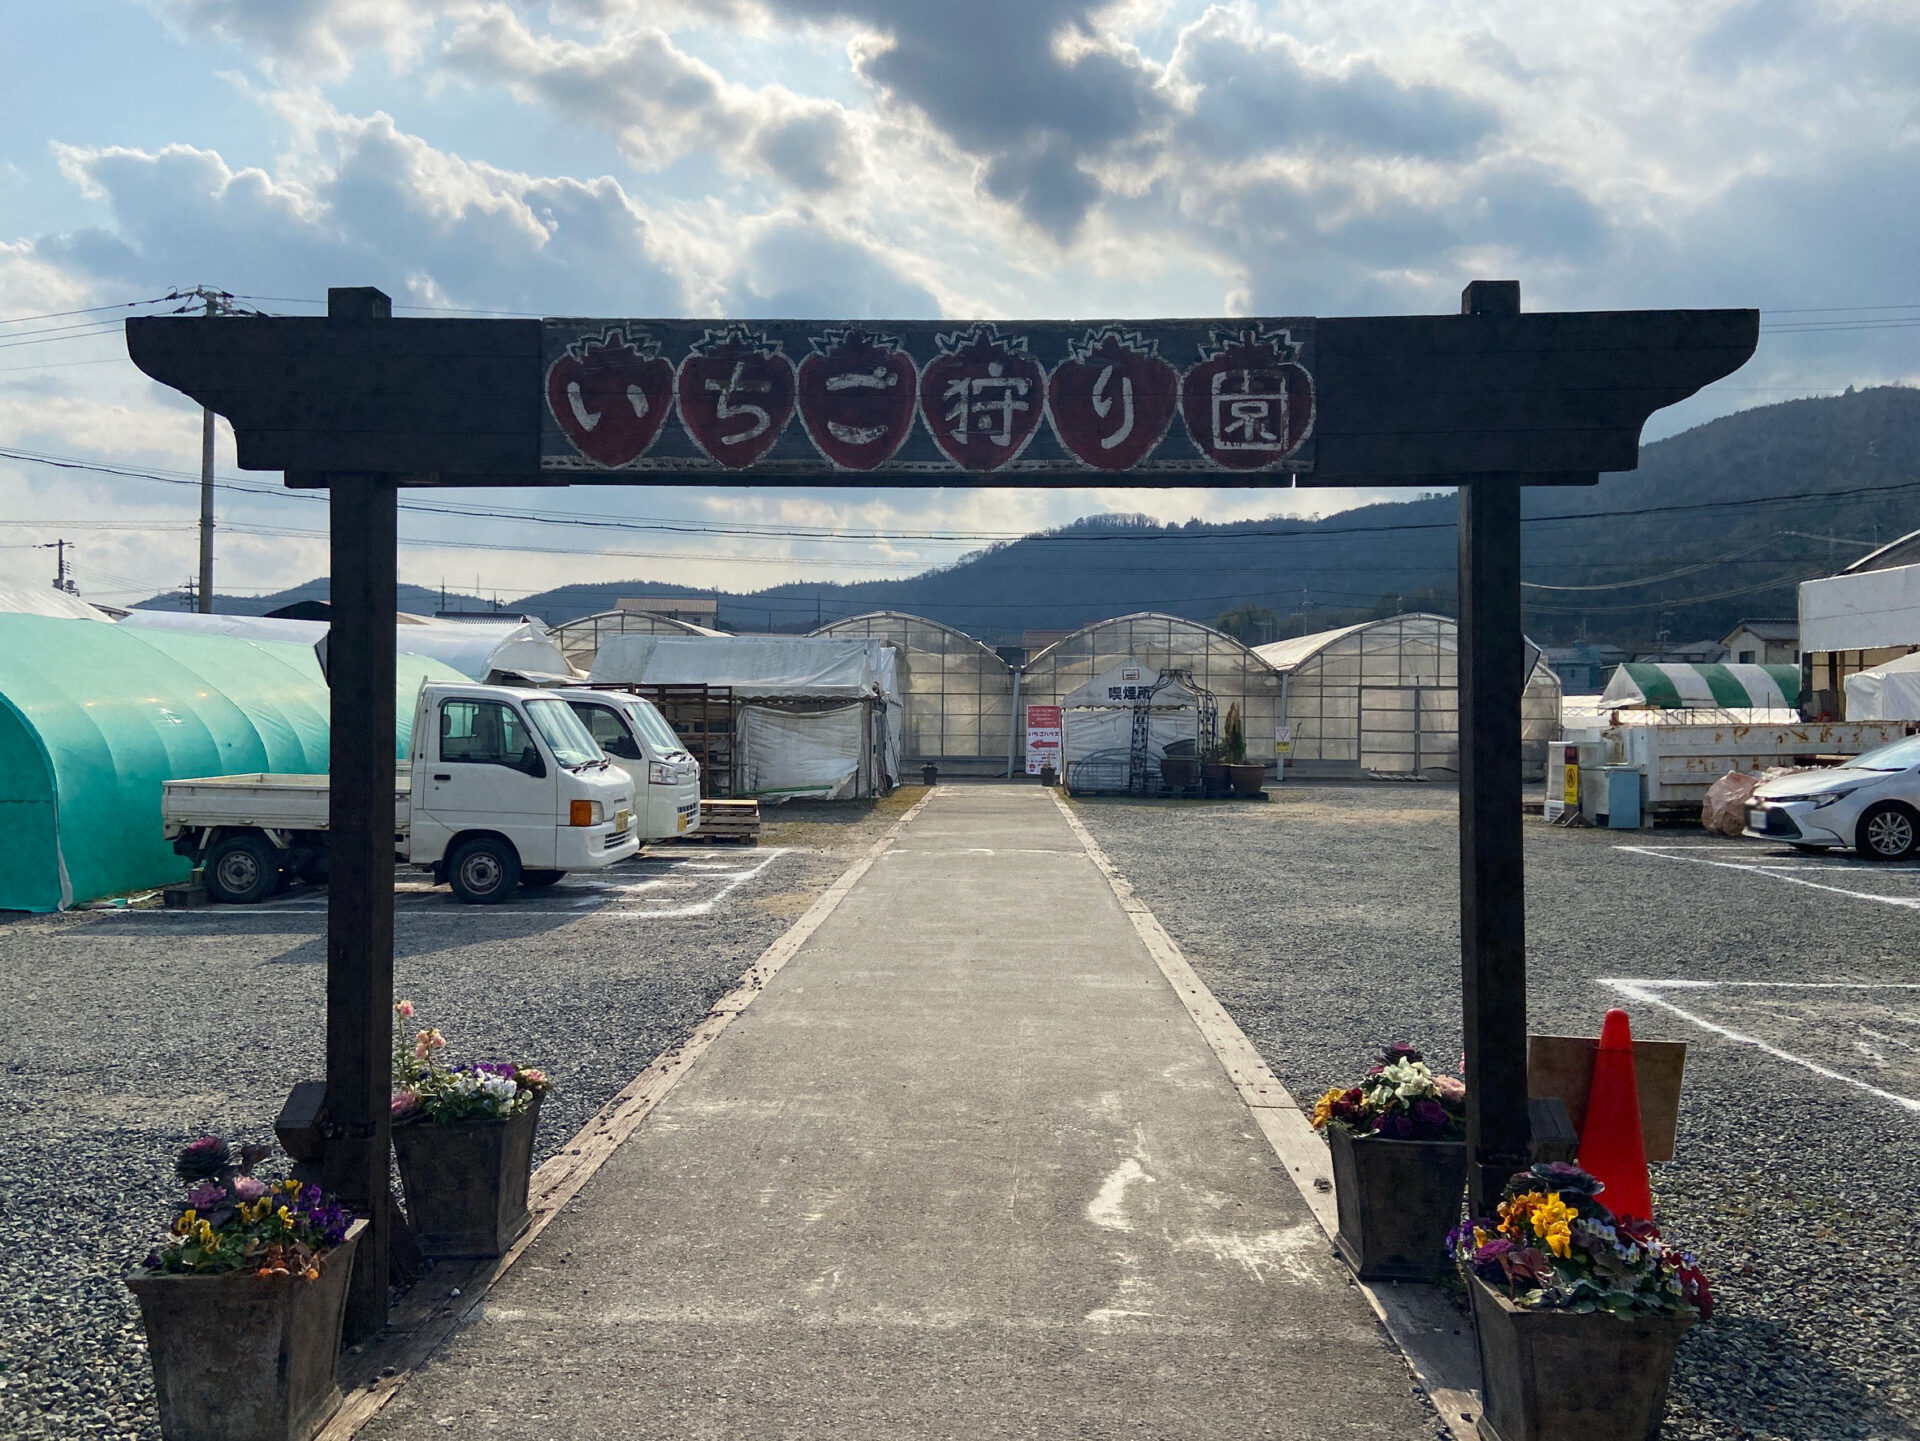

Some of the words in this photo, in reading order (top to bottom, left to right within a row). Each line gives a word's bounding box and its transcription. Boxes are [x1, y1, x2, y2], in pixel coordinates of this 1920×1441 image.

[567, 361, 1290, 451] いちご狩り園
[1108, 685, 1151, 700] 喫煙所
